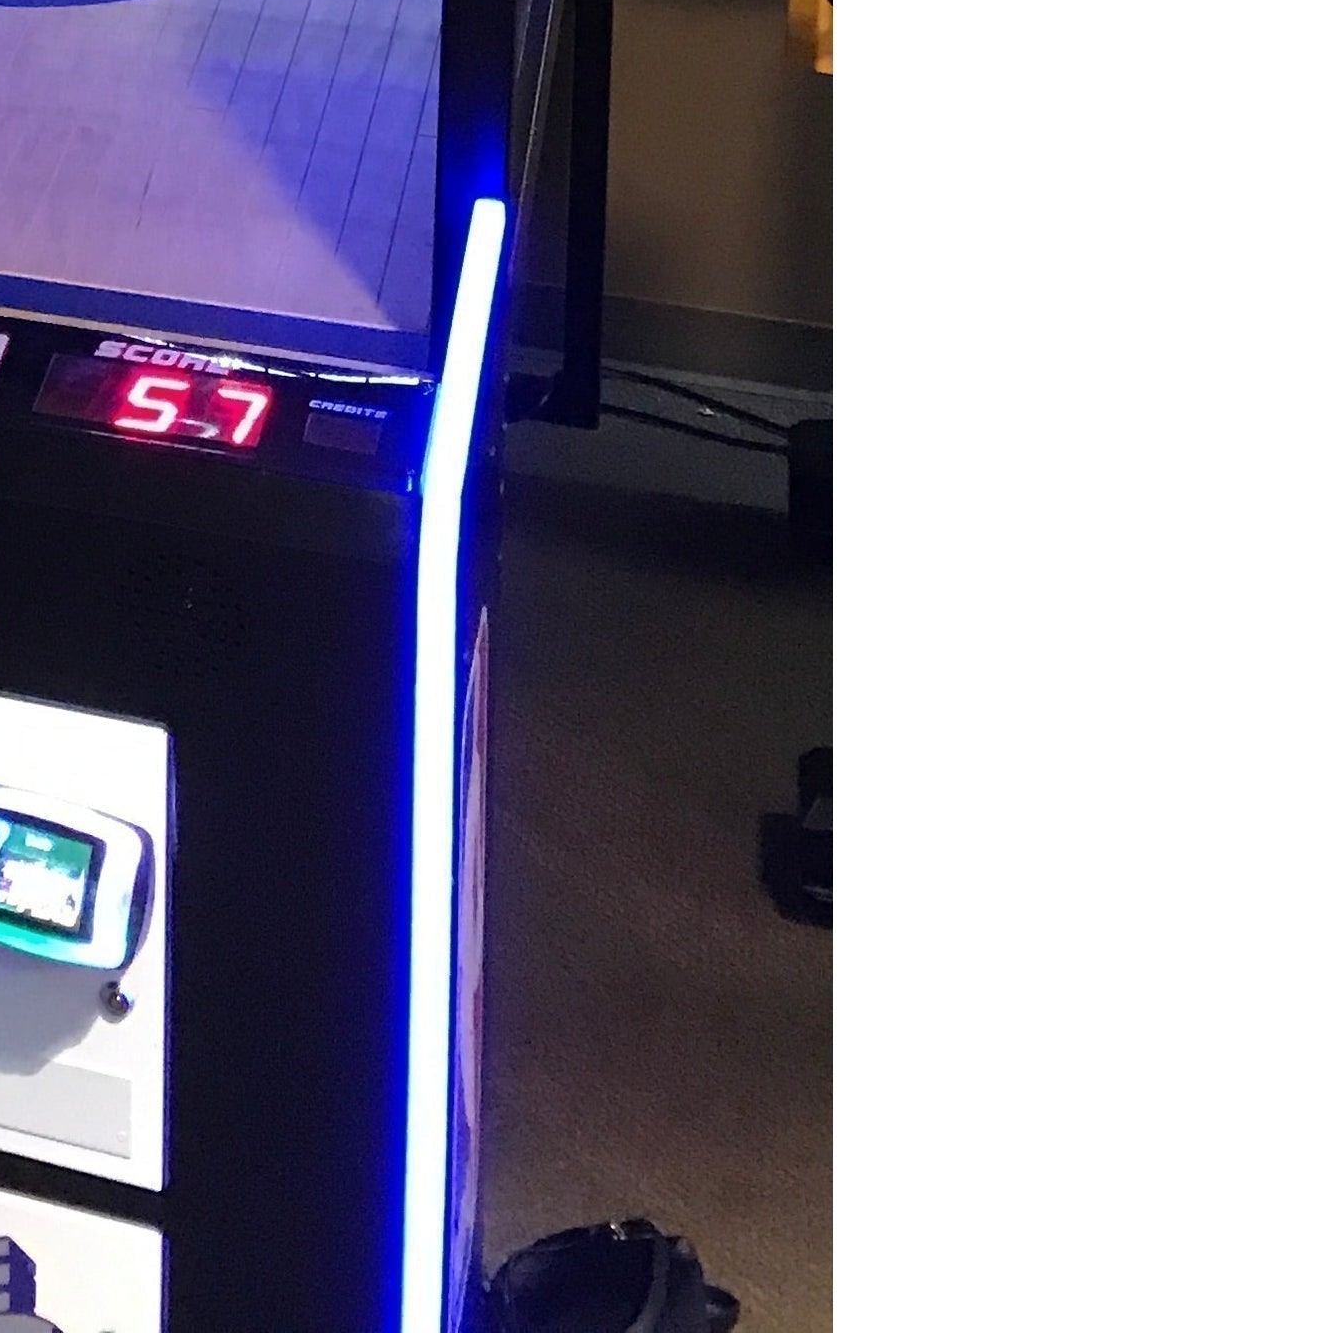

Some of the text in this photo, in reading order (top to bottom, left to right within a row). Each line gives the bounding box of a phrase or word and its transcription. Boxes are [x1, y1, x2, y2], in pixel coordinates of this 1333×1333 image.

[94, 340, 230, 376] SCORE
[113, 376, 269, 446] 57
[308, 399, 389, 420] CREDITS
